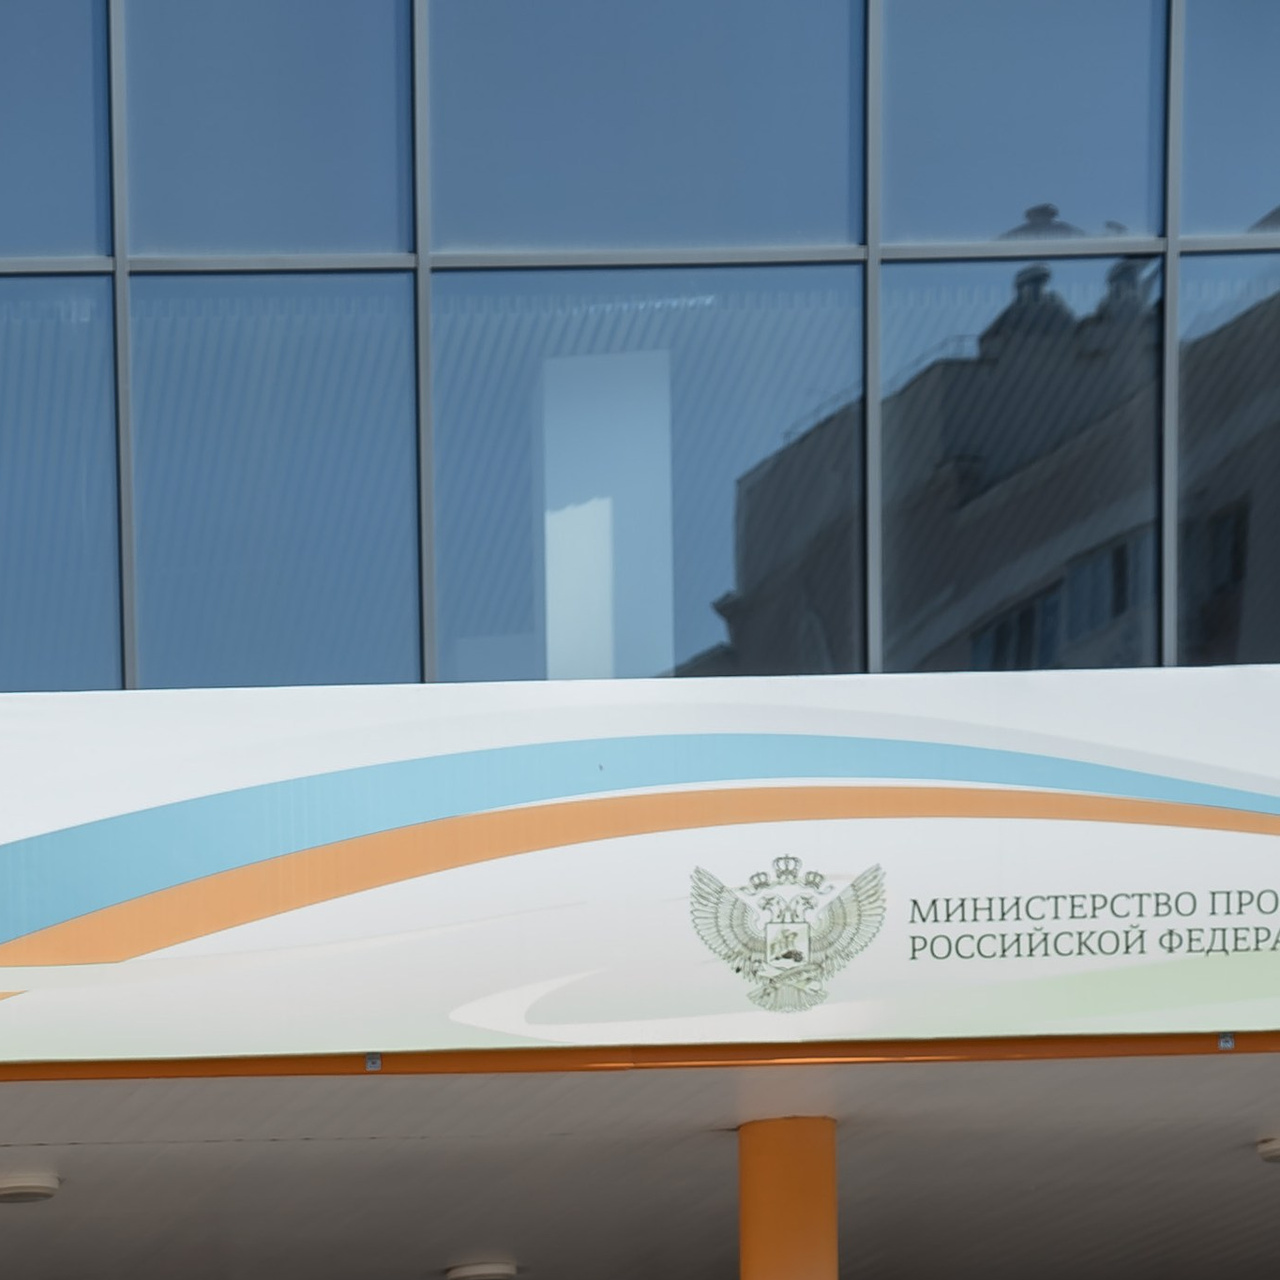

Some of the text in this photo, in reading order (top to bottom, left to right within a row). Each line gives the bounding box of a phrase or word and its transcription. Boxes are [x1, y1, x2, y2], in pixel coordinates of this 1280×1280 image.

[909, 889, 1279, 924] МИНИСТЕРСТВО ПРО
[909, 924, 1146, 960] РОССИЙСКОЙ
